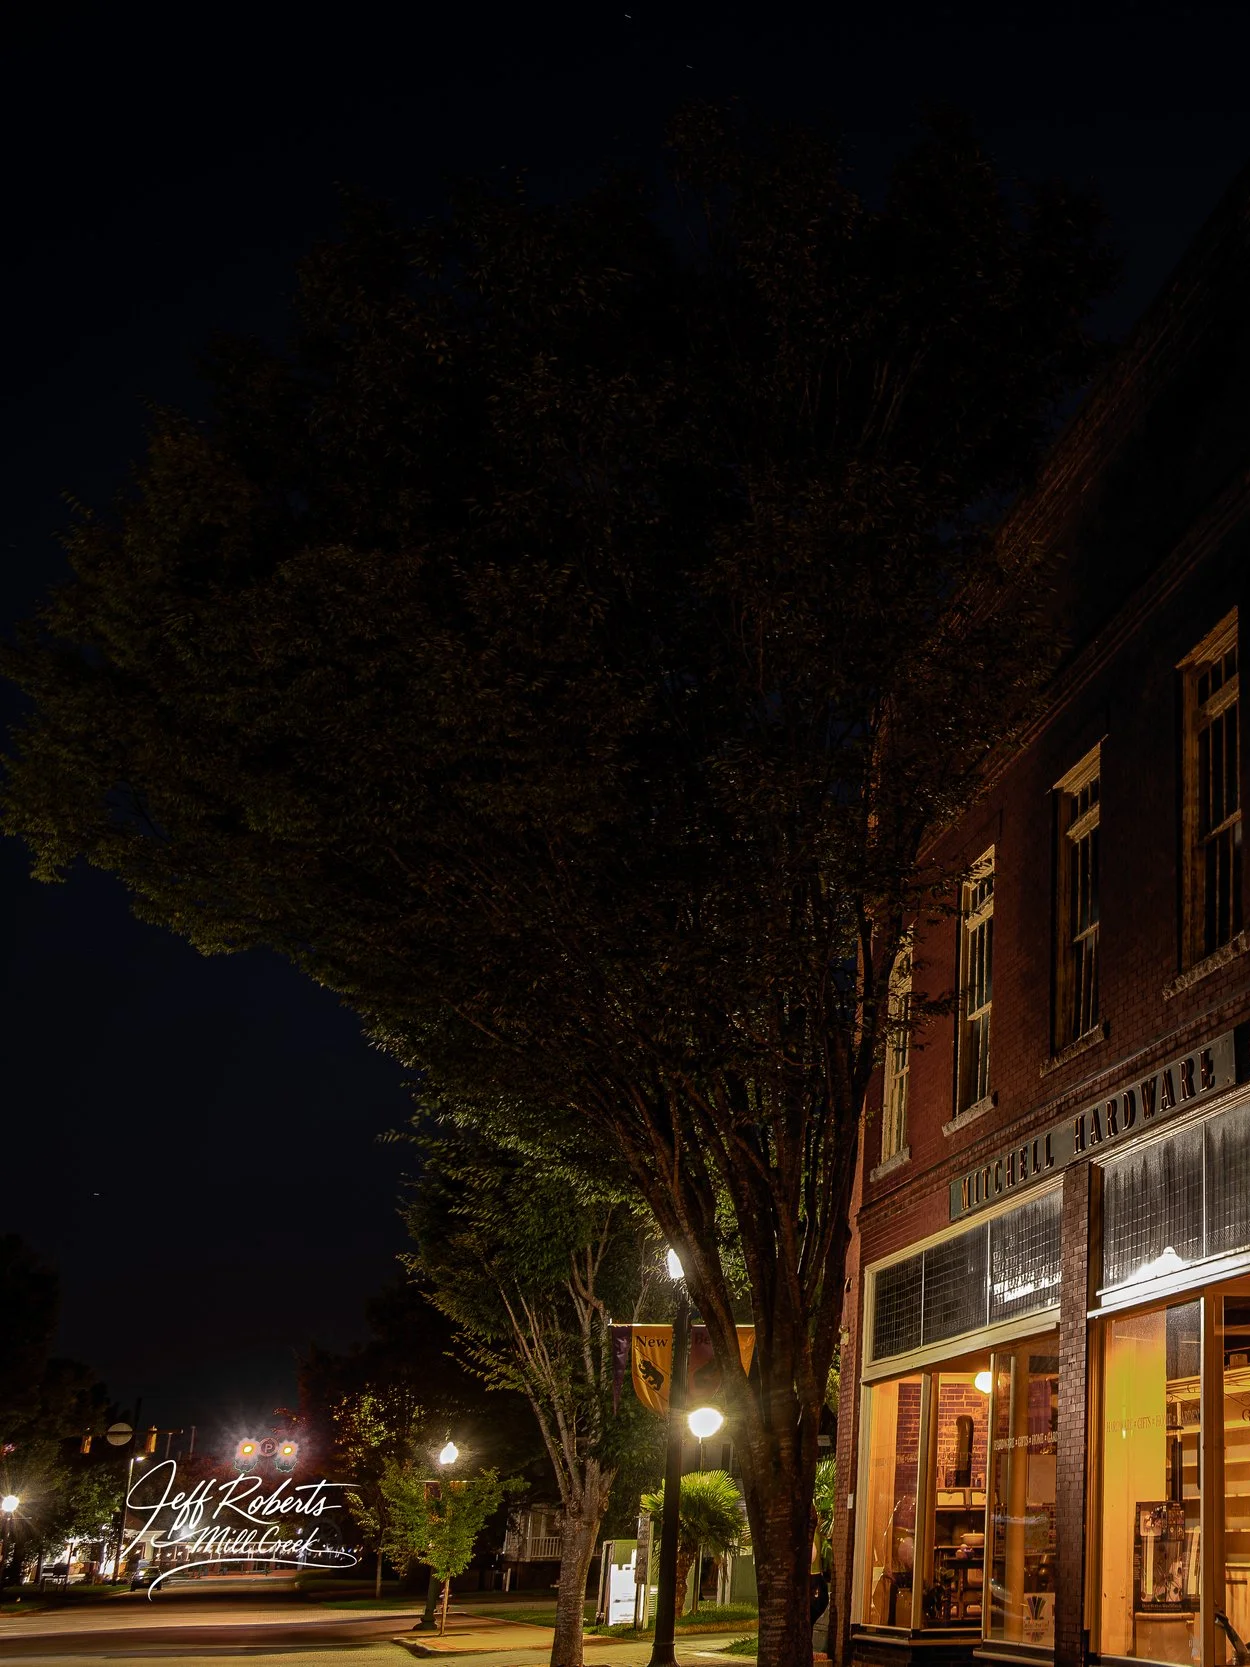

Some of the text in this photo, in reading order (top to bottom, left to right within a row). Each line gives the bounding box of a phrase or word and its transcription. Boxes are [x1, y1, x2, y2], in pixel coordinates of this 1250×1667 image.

[961, 1047, 1216, 1210] MITCHELL HARDWARE
[636, 1335, 668, 1347] New
